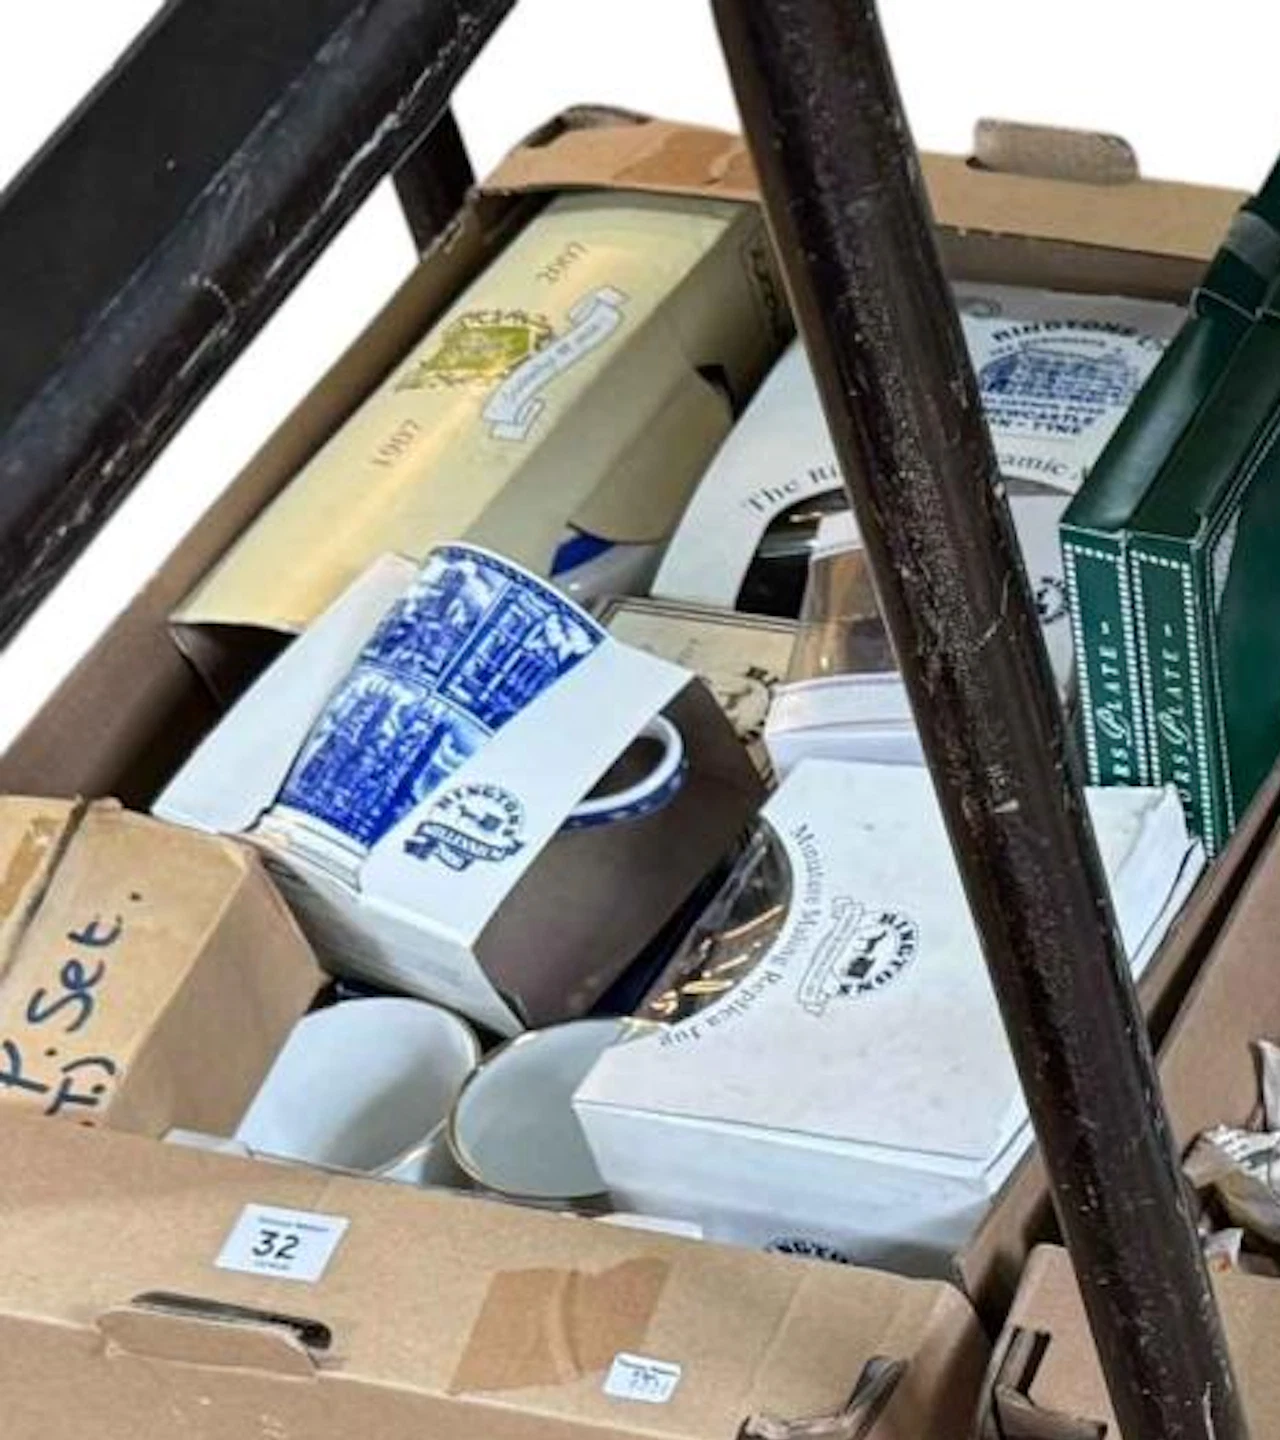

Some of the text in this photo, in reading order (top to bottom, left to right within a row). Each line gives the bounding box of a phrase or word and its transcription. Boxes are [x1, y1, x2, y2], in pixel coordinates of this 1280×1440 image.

[741, 479, 798, 512] The
[706, 970, 782, 1028] Replica
[251, 1228, 300, 1260] 32
